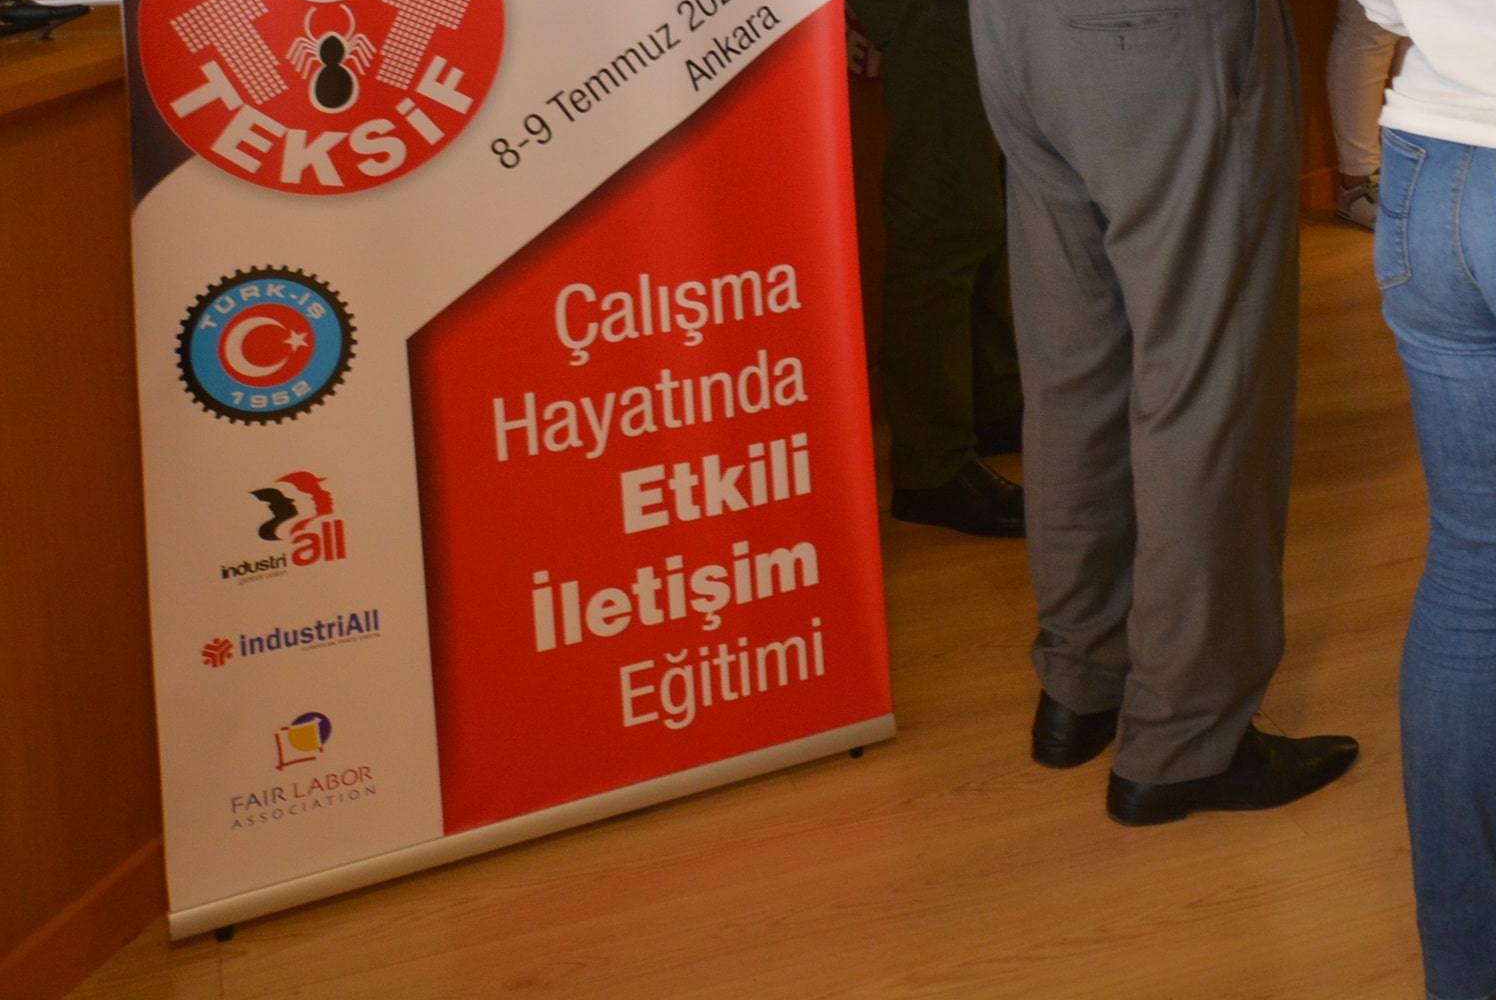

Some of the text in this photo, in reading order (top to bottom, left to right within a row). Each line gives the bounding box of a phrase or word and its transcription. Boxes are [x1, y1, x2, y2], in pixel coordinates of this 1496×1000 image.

[490, 113, 553, 169] 8-9
[545, 22, 681, 122] Temmuz
[684, 5, 782, 92] Ankara
[170, 55, 474, 187] TEKSİF
[200, 283, 326, 330] TÜRK-İŞ
[554, 263, 802, 367] Çalışma
[231, 380, 312, 409] 1952
[493, 348, 808, 462] Hayatında
[619, 431, 812, 535] Etkili
[221, 553, 288, 579] industri
[531, 540, 820, 653] İletişim
[239, 609, 380, 657] industriAll
[619, 616, 825, 730] Eğitimi
[231, 765, 374, 814] FAIR LABOR
[231, 786, 376, 831] ASSOCIATION
